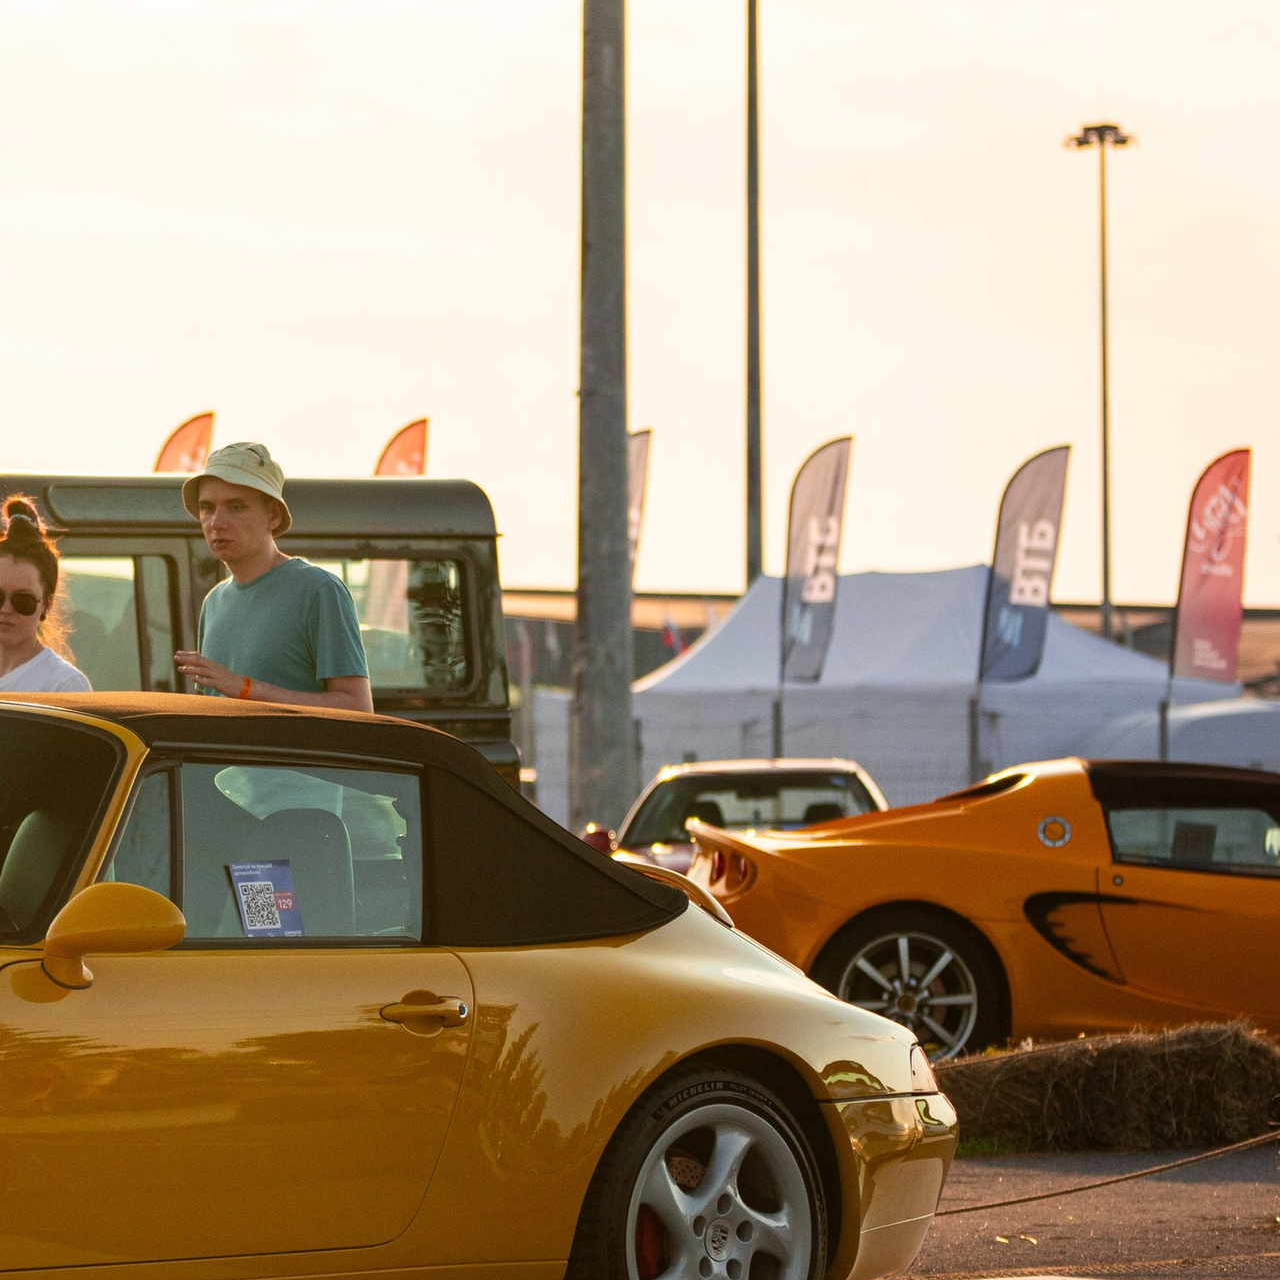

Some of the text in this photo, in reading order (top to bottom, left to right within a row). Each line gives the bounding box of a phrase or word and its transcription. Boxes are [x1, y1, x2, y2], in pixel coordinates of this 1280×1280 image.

[1009, 518, 1055, 607] ВТБ
[278, 898, 293, 909] 129
[668, 1081, 724, 1108] MICHELIN
